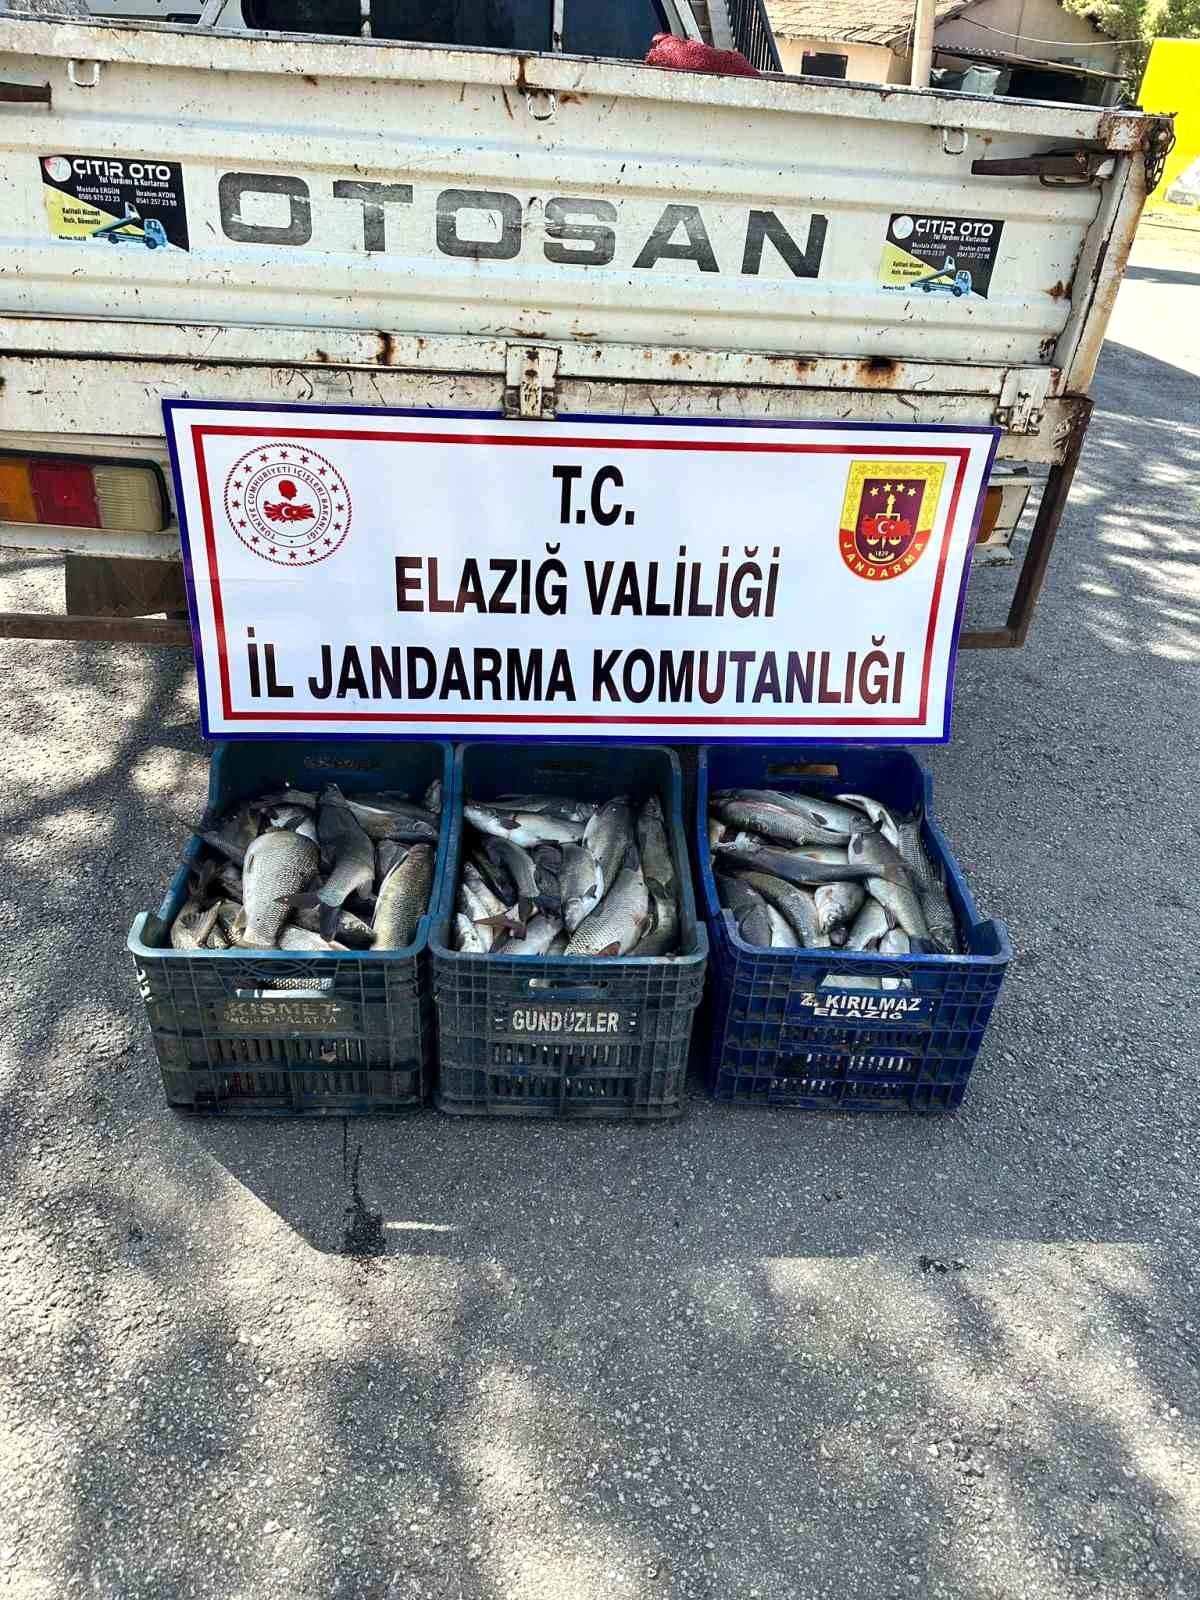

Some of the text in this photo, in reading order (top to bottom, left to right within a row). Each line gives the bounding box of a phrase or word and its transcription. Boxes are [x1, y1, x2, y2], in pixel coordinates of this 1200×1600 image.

[72, 159, 171, 181] ÇITIR OTO
[218, 171, 829, 278] OTOSAN
[916, 219, 994, 237] ÇITIR OTO
[552, 465, 635, 526] T.C.
[394, 542, 781, 619] ELAZIĞ VALİLİĞİ
[843, 541, 924, 578] JANDARMA
[246, 626, 906, 705] İL JANDARMA KOMUTANLIĞI
